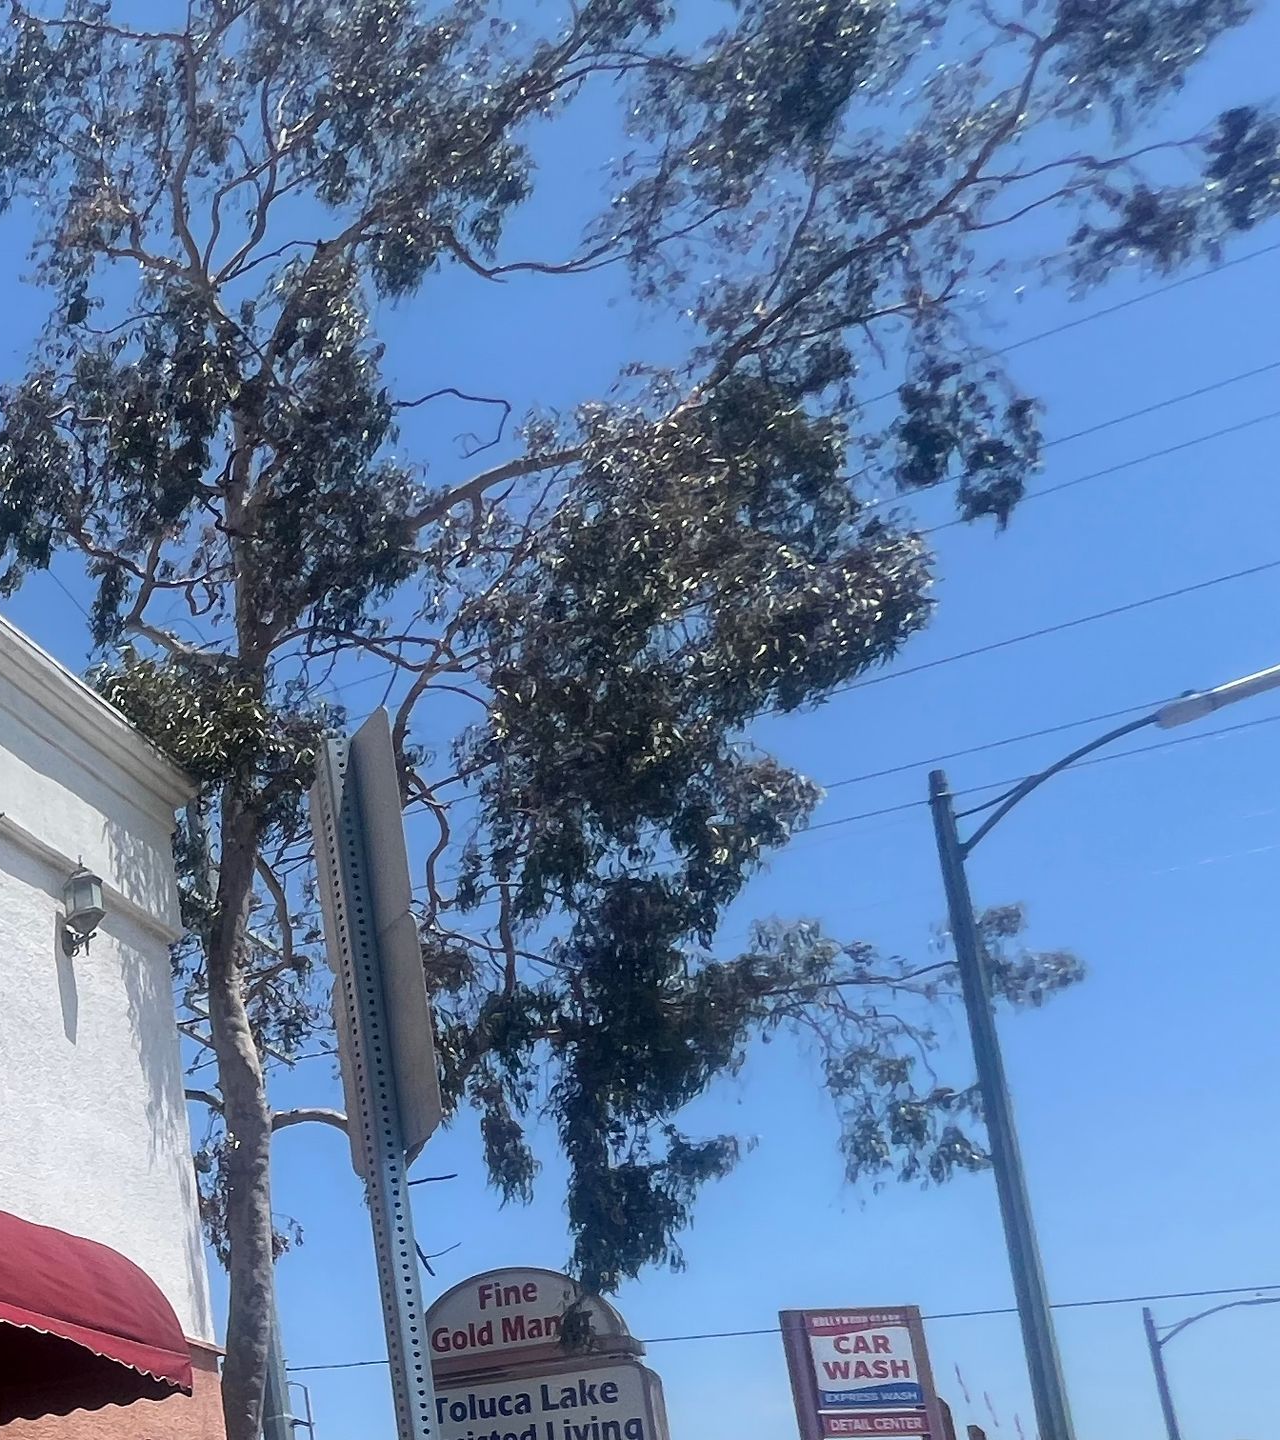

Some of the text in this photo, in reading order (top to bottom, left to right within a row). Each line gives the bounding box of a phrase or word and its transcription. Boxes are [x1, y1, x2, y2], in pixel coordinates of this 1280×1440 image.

[478, 1282, 538, 1310] Fine
[431, 1313, 563, 1353] Gold Man
[833, 1335, 893, 1355] CAR
[822, 1359, 910, 1381] WASH
[435, 1378, 619, 1425] Toluca Lake
[825, 1391, 918, 1403] EXPRESS WASH
[830, 1417, 922, 1432] DETAIL CENTER
